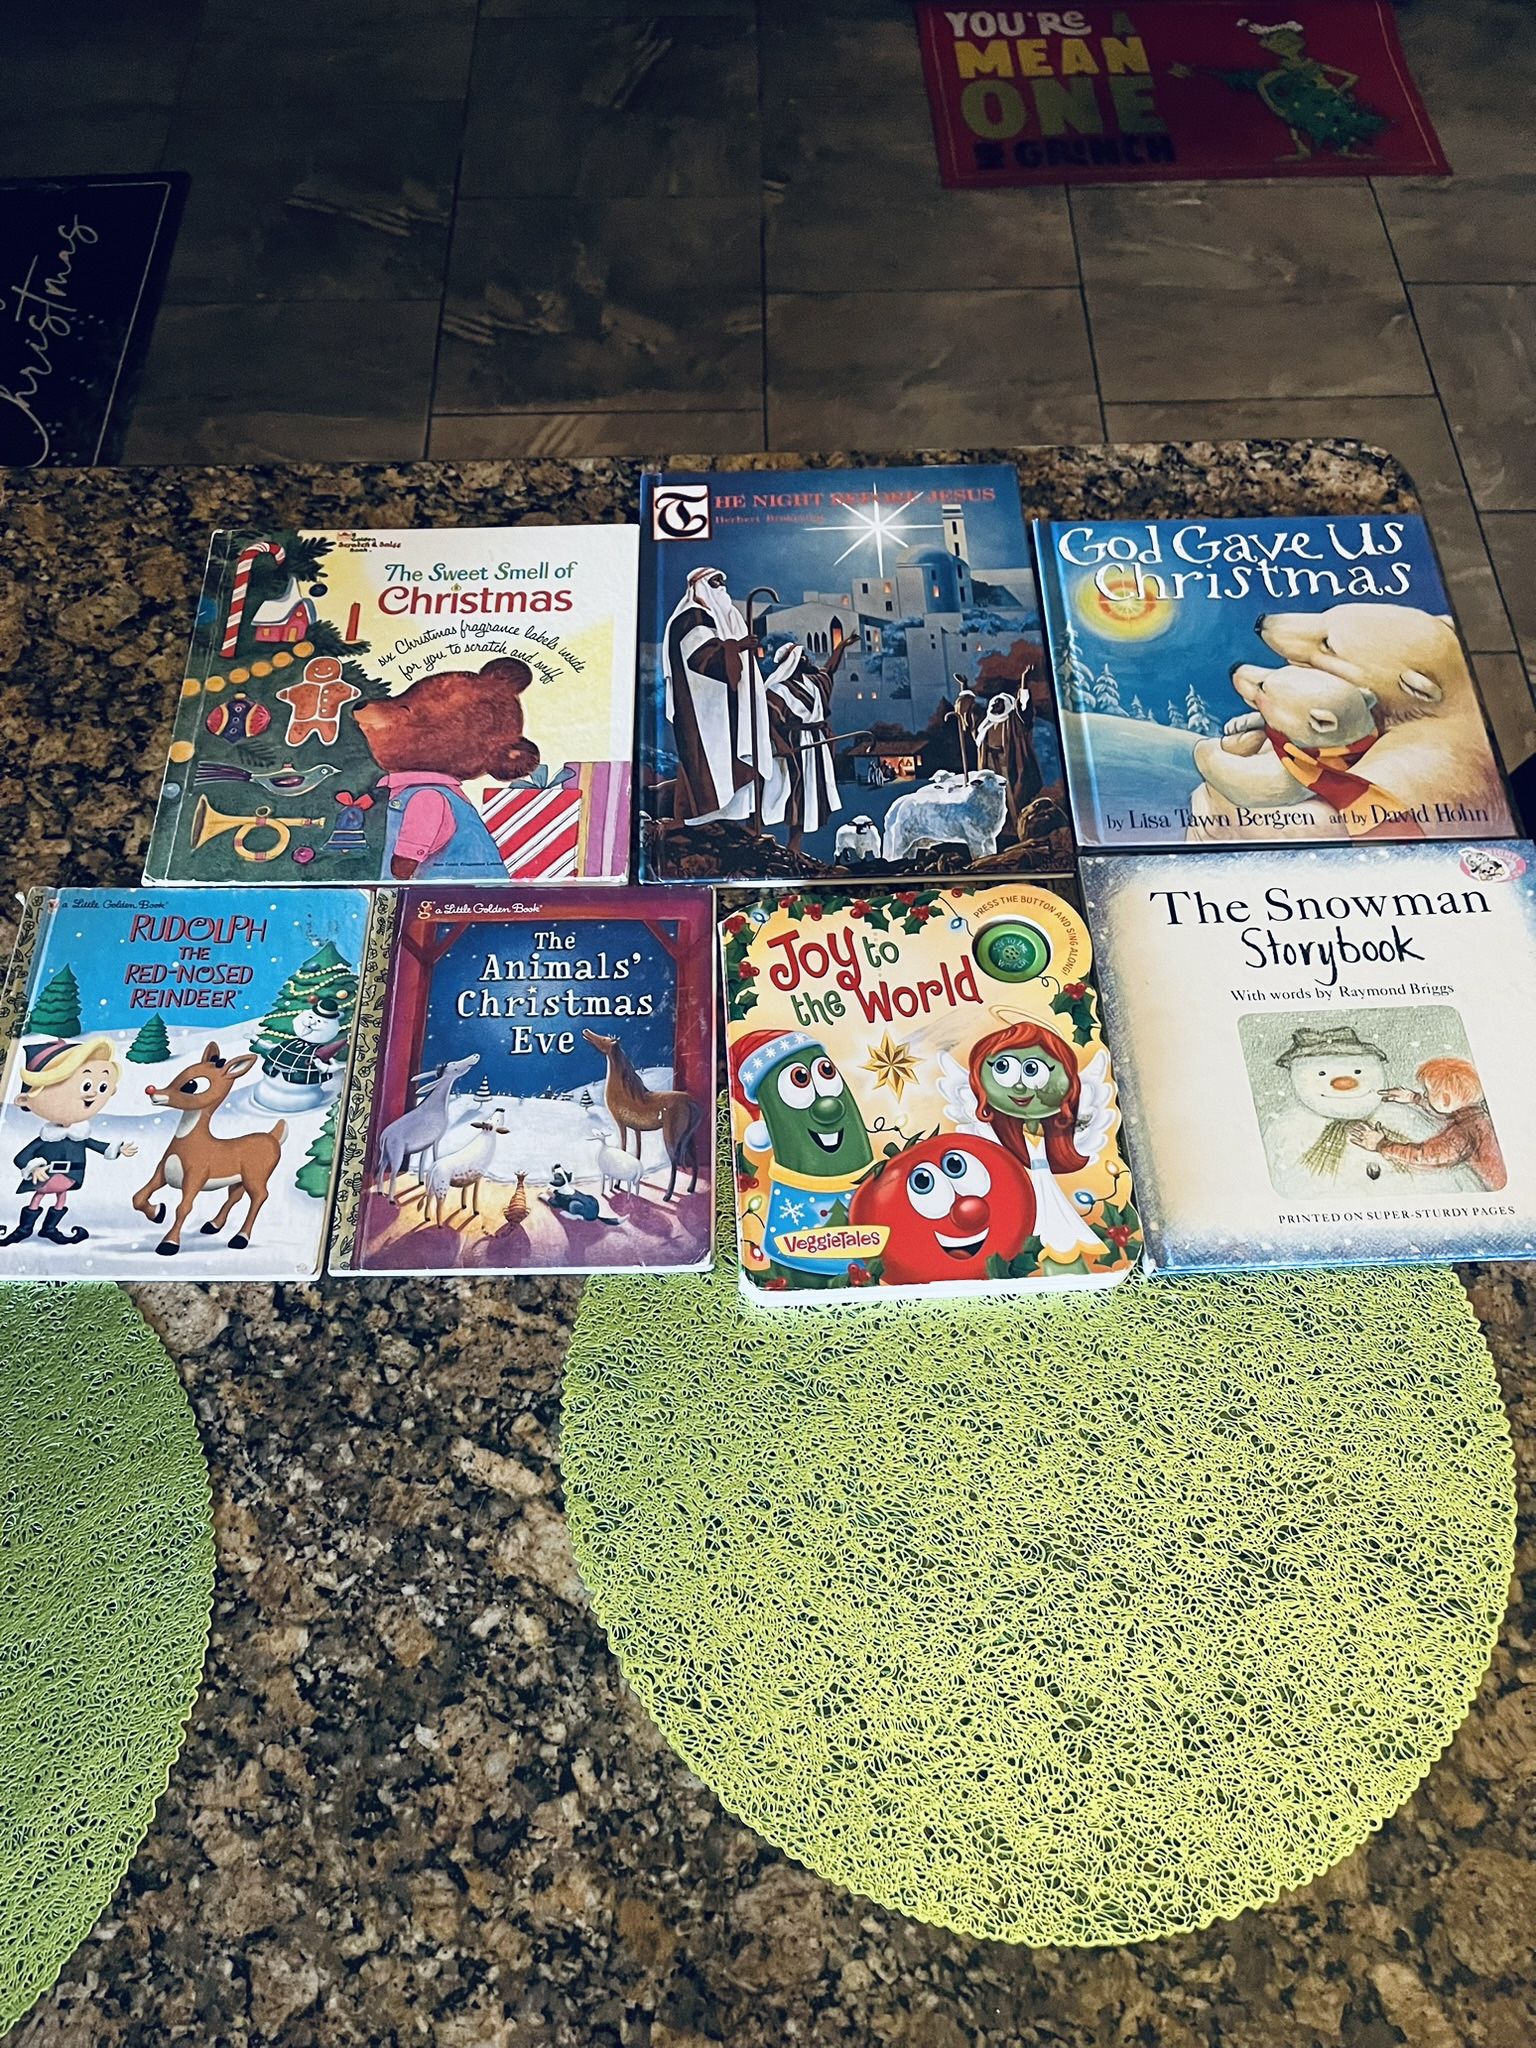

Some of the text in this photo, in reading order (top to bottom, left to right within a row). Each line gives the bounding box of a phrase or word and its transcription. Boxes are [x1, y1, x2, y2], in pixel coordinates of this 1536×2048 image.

[1112, 11, 1137, 35] A
[953, 36, 1151, 79] MEAN
[960, 74, 1168, 140] ONE
[752, 493, 823, 507] NIGHT
[928, 488, 995, 503] JESUS
[1058, 525, 1162, 566] God
[1172, 525, 1324, 565] Gave
[384, 561, 578, 582] The Sweet Smell of
[1094, 559, 1412, 602] Christmas
[378, 585, 573, 615] Christmas
[378, 620, 586, 673] six Christmas fragrance labels inside
[399, 641, 563, 684] for you to scratch and sniff
[1107, 802, 1488, 832] by Lisa Tawn Bergren art by David Hohn
[72, 899, 100, 909] Little
[103, 899, 137, 909] Golden
[138, 900, 165, 909] Book
[435, 902, 540, 915] a Little Golden Book
[1150, 887, 1492, 926] The Snowman
[129, 914, 268, 944] RUDOLPH
[534, 931, 576, 950] The
[973, 895, 1079, 976] PRESS THE BUTTON AND SING ALONG!
[178, 947, 210, 961] THE
[767, 925, 900, 992] Joy to
[1241, 925, 1426, 986] Storybook
[124, 964, 254, 985] RED-NOSED
[129, 988, 237, 1009] REINDEER
[456, 986, 653, 1018] Christmas
[790, 954, 985, 1027] the World
[1230, 982, 1455, 1002] With words by Raymond Briggs
[510, 1025, 576, 1055] Eve
[1278, 1206, 1516, 1224] PRINTED ON SUPER-STURDY PAGES
[783, 1229, 881, 1253] VeggieTales
